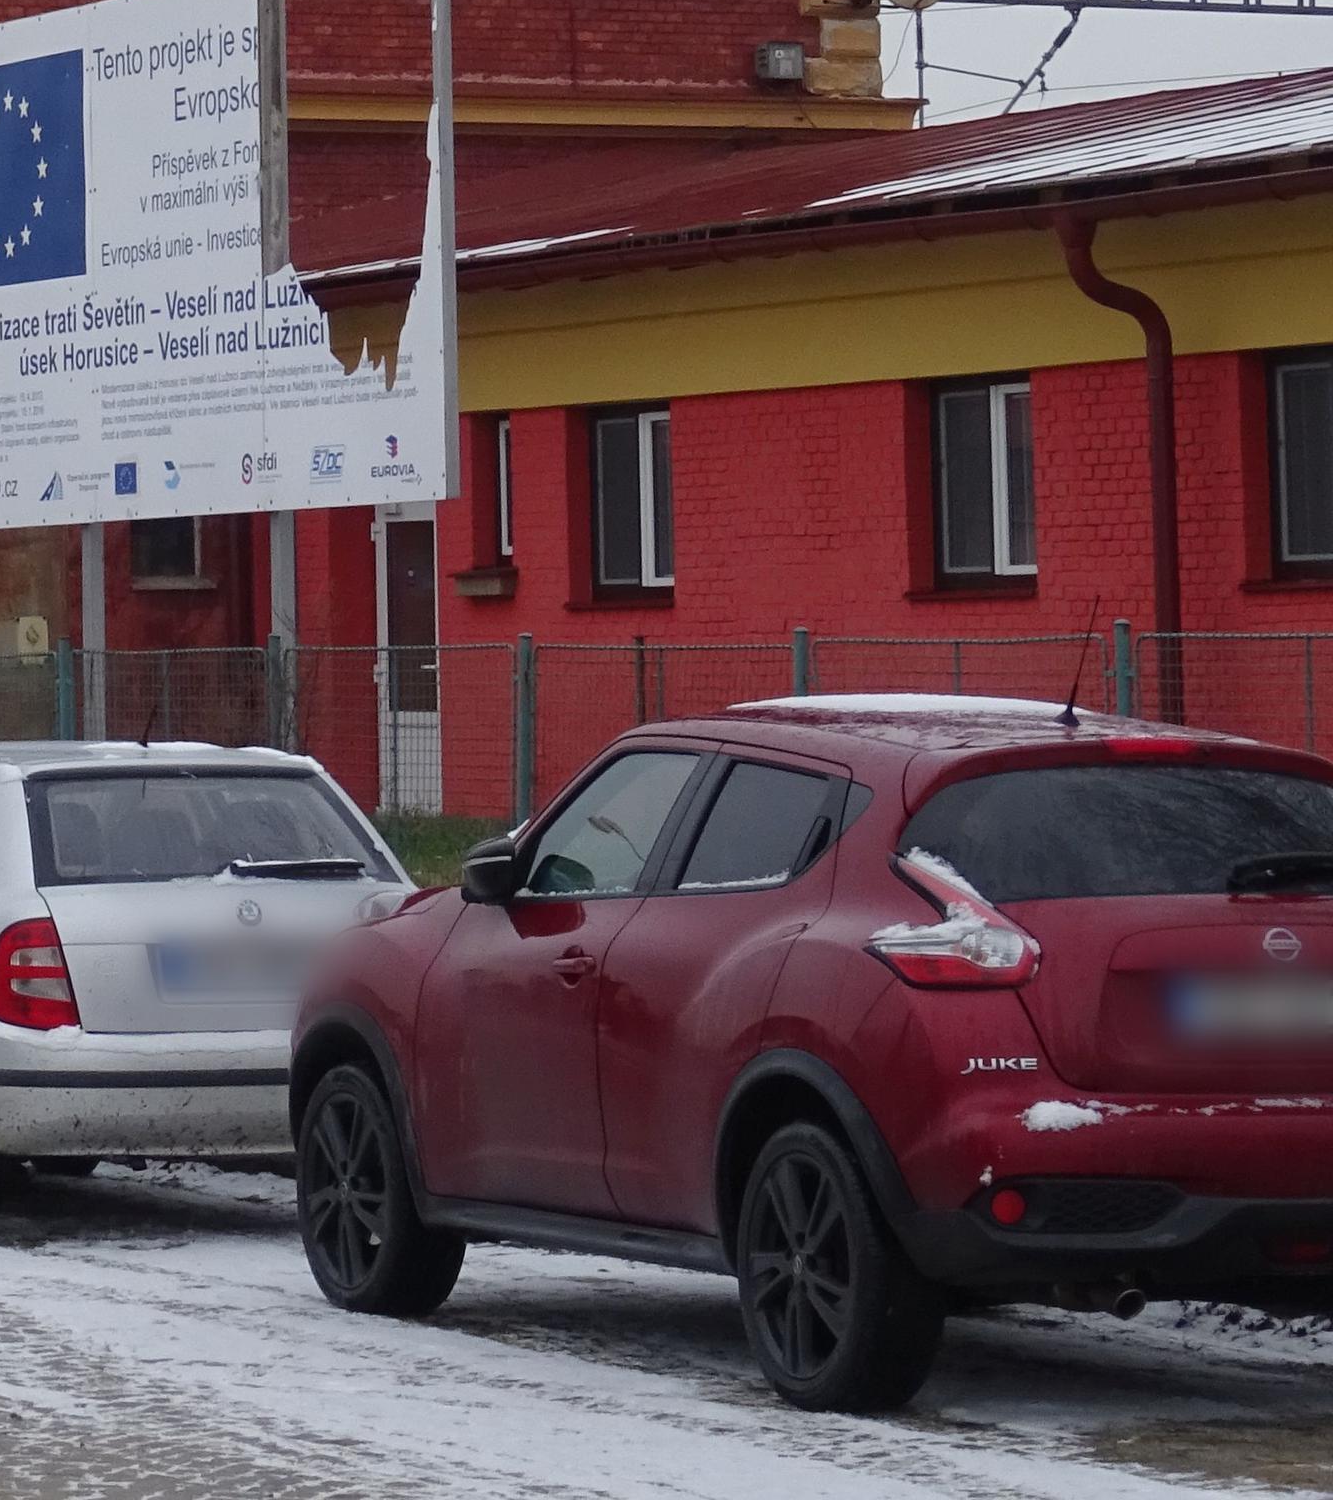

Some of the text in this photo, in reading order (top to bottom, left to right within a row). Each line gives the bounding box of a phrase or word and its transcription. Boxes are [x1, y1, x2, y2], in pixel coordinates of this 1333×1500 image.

[93, 44, 143, 81] Tento
[149, 27, 213, 80] projekt
[218, 24, 235, 68] je
[152, 145, 218, 180] Příspěvek
[222, 148, 230, 168] z
[139, 195, 147, 213] v
[151, 179, 219, 212] maximální
[223, 174, 249, 207] výši
[102, 235, 161, 268] Evropská
[165, 232, 193, 259] unie
[207, 222, 261, 252] Investice
[45, 304, 77, 336] trati
[83, 295, 145, 331] Ševětín
[166, 285, 218, 320] Veselí
[223, 280, 256, 314] nad
[19, 346, 58, 377] úsek
[64, 337, 139, 371] Horusice
[158, 326, 209, 361] Veselí
[216, 322, 248, 355] nad
[257, 452, 277, 471] sfdi
[370, 463, 415, 478] EUROVIA
[960, 1058, 1038, 1075] JUKE
